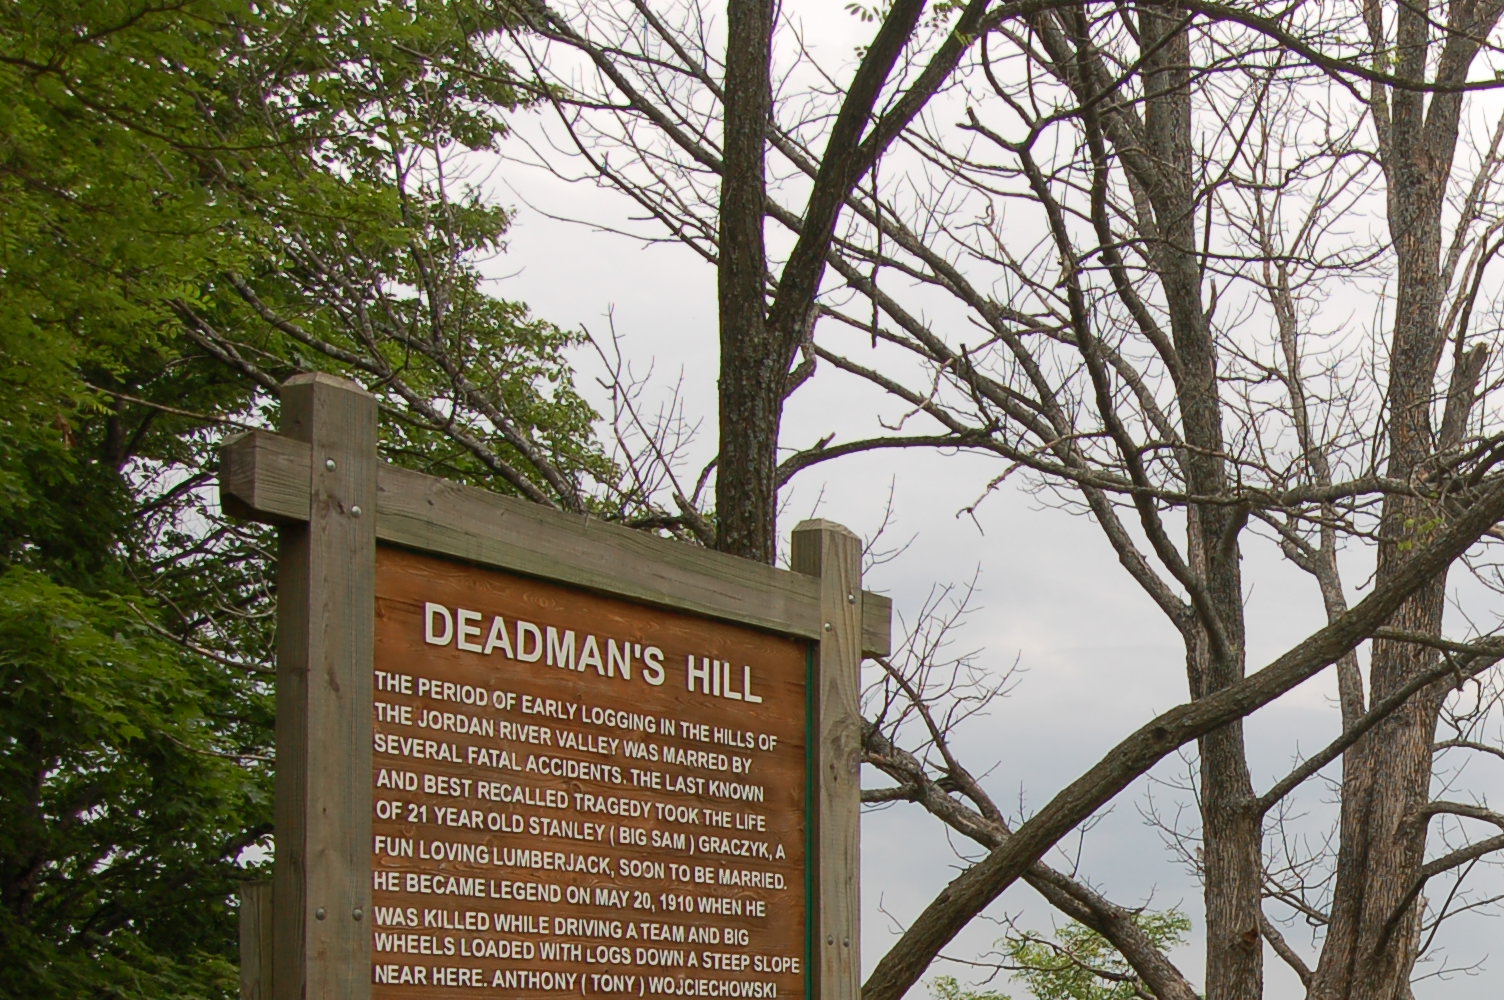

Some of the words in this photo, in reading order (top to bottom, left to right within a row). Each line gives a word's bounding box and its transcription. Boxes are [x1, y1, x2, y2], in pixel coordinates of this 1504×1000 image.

[425, 601, 665, 686] DEADMAN'S
[688, 654, 762, 703] HILL
[374, 670, 412, 695] THE
[418, 677, 488, 706] PERIOD
[492, 690, 517, 710] OF
[522, 695, 577, 720] EARLY
[582, 705, 656, 733] LOGGING
[660, 718, 675, 736] IN
[679, 721, 710, 742] THE
[714, 727, 755, 749] HILLS
[758, 733, 777, 751] OF
[374, 702, 413, 725] THE
[417, 709, 494, 737] JORDAN
[499, 721, 551, 746] RIVER
[555, 730, 619, 755] VALLEY
[623, 740, 659, 761] WAS
[663, 746, 728, 771] MARRED
[732, 756, 752, 774] BY
[374, 733, 463, 763] SEVERAL
[468, 746, 522, 771] FATAL
[525, 755, 627, 784] ACCIDENTS.
[630, 768, 661, 789] THE
[665, 774, 705, 794] LAST
[709, 779, 764, 802] KNOWN
[376, 768, 418, 791] AND
[424, 774, 472, 797] BEST
[477, 781, 569, 809] RECALLED
[573, 793, 652, 818] TRAGEDY
[655, 802, 699, 824] TOOK
[702, 809, 732, 828] THE
[736, 813, 766, 832] LIFE
[376, 800, 402, 820] OF
[407, 803, 427, 823] 21
[434, 806, 484, 829] YEAR
[487, 812, 524, 833] OLD
[528, 816, 606, 841] STANLEY
[698, 835, 773, 861] GRACZYK,
[775, 844, 786, 859] A
[374, 835, 413, 857] FUN
[419, 840, 489, 864] LOVING
[493, 847, 615, 878] LUMBERJACK,
[619, 858, 665, 879] SOON
[668, 863, 691, 882] TO
[694, 866, 715, 884] BE
[718, 868, 787, 890] MARRIED.
[374, 871, 400, 891] HE
[406, 873, 486, 897] BECAME
[490, 880, 561, 903] LEGEND
[566, 885, 590, 905] ON
[595, 888, 630, 908] MAY
[633, 890, 655, 912] 20,
[659, 893, 694, 912] 1910
[697, 896, 742, 915] WHEN
[746, 900, 766, 917] HE
[374, 906, 418, 927] WAS
[424, 908, 490, 931] KILLED
[493, 913, 549, 934] WHILE
[554, 917, 622, 939] DRIVING
[625, 922, 638, 939] A
[639, 923, 684, 943] TEAM
[688, 926, 720, 944] AND
[724, 928, 749, 946] BIG
[374, 932, 455, 956] WHEELS
[460, 938, 535, 959] LOADED
[539, 942, 582, 961] WITH
[586, 945, 631, 965] LOGS
[636, 947, 684, 966] DOWN
[687, 951, 698, 967] A
[702, 951, 750, 971] STEEP
[753, 955, 800, 973] SLOPE
[375, 964, 427, 985] NEAR
[432, 967, 487, 987] HERE.
[492, 969, 577, 990] ANTHONY
[648, 976, 777, 998] WOJCIECHOWSKI
